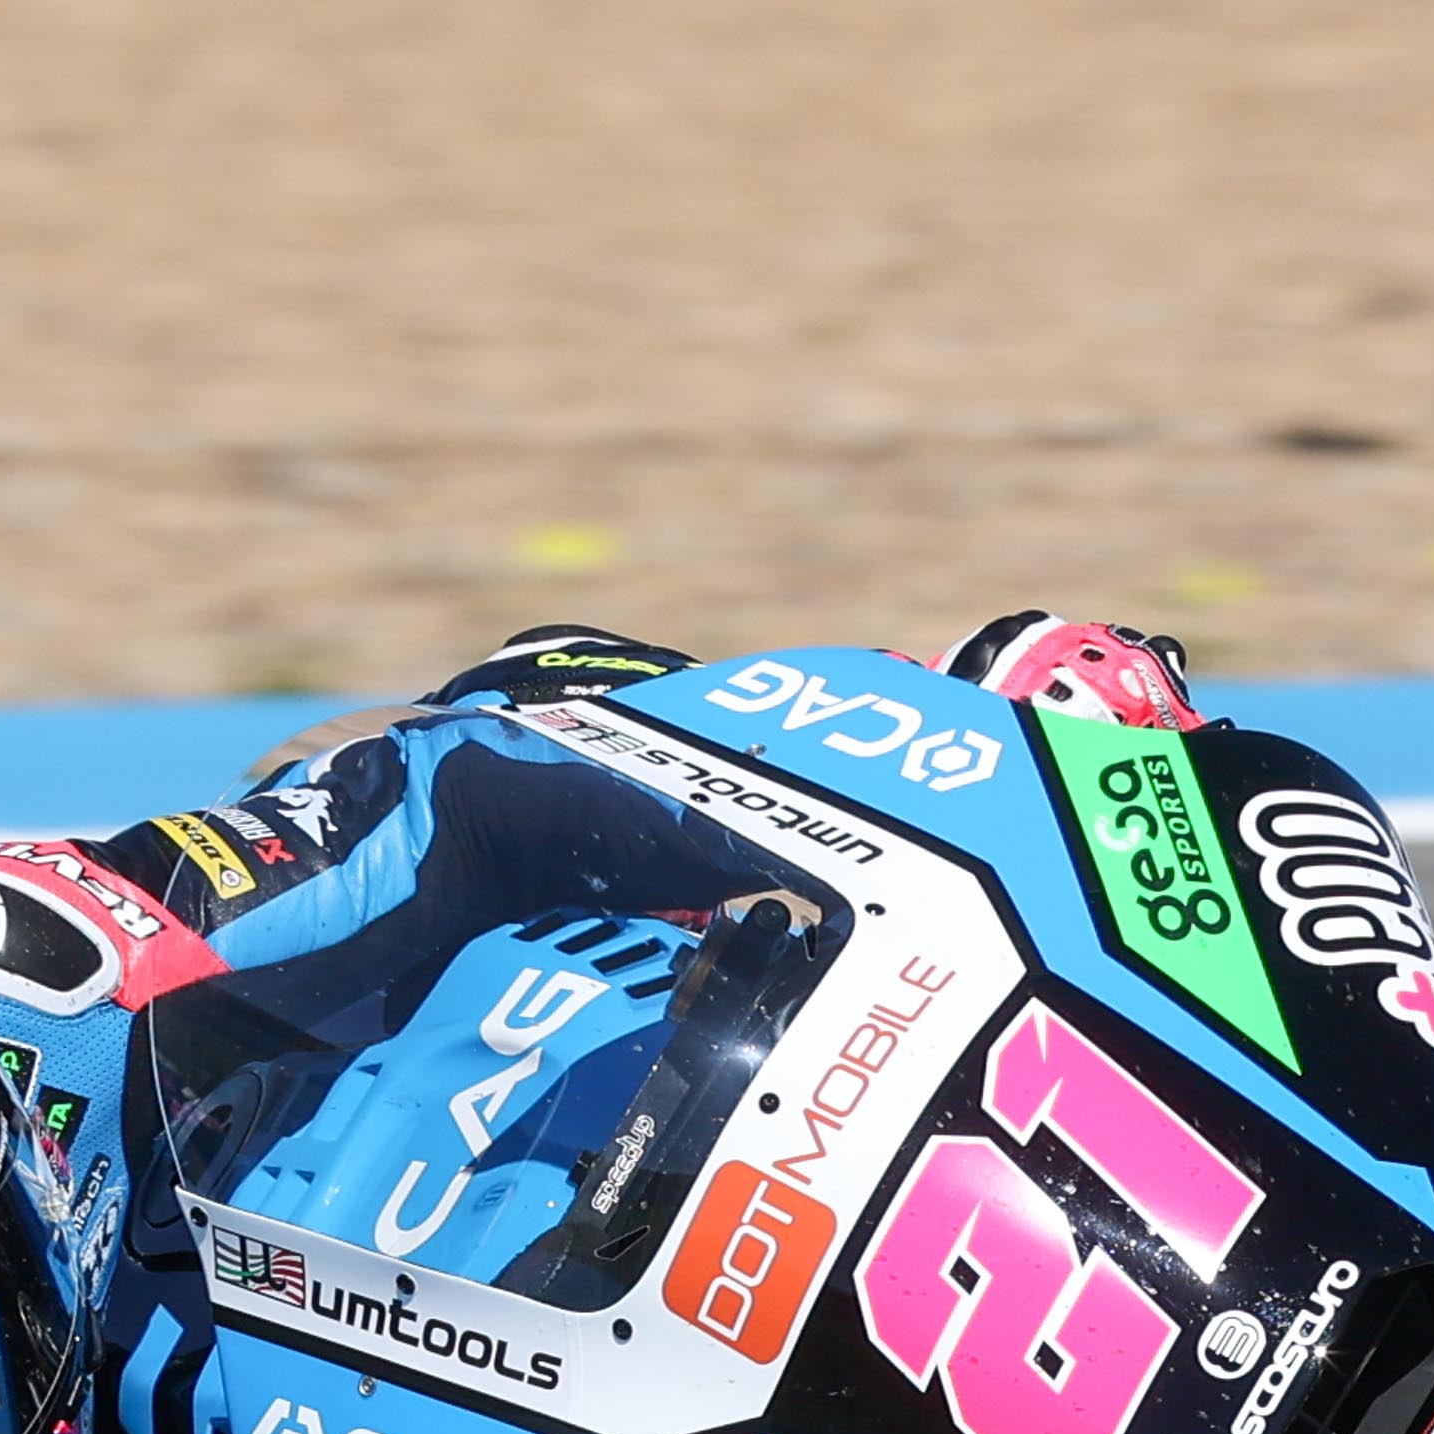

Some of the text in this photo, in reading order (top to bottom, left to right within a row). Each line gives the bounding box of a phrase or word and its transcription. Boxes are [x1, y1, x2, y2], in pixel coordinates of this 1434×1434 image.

[703, 659, 923, 757] CAG
[1146, 759, 1207, 878] SPORTS
[374, 967, 612, 1258] CAG
[697, 955, 957, 1341] DOT MOBILE
